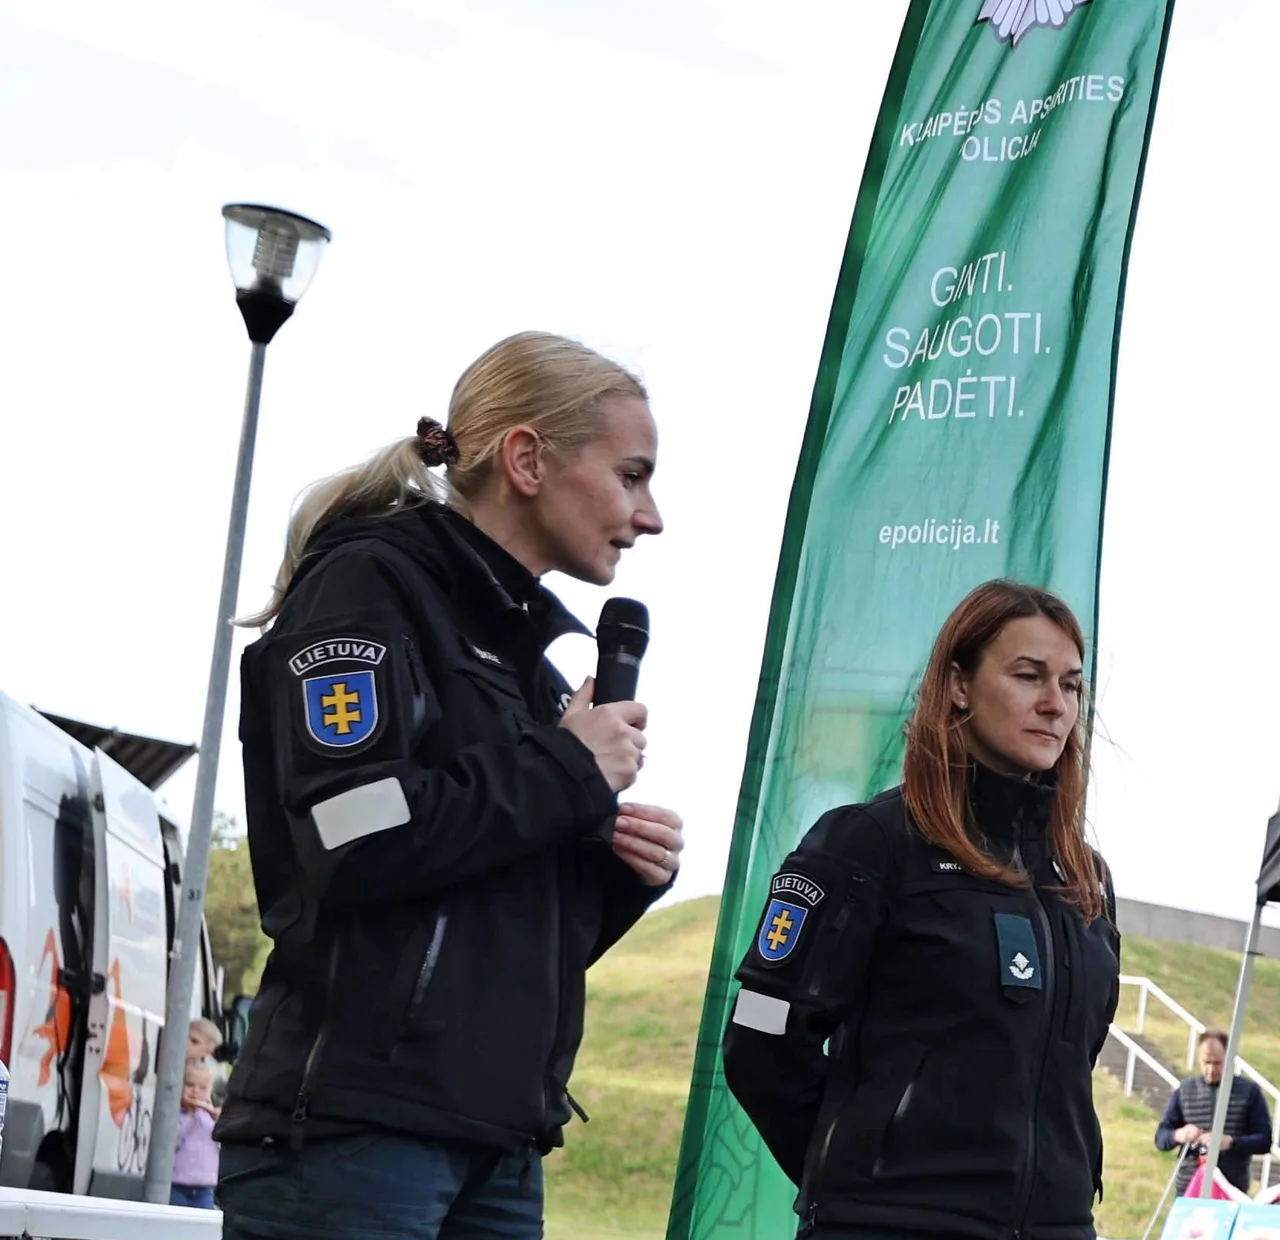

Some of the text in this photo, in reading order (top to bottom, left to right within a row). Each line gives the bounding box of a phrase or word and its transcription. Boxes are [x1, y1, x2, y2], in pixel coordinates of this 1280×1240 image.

[958, 128, 1041, 162] OLICIJA
[930, 251, 1013, 307] GINTI.
[883, 312, 1050, 369] SAUGOTI.
[888, 369, 1024, 424] PADĖTI.
[879, 518, 1000, 550] epolicija.lt
[294, 643, 377, 670] LIETUVA
[775, 876, 819, 902] LIETUVA
